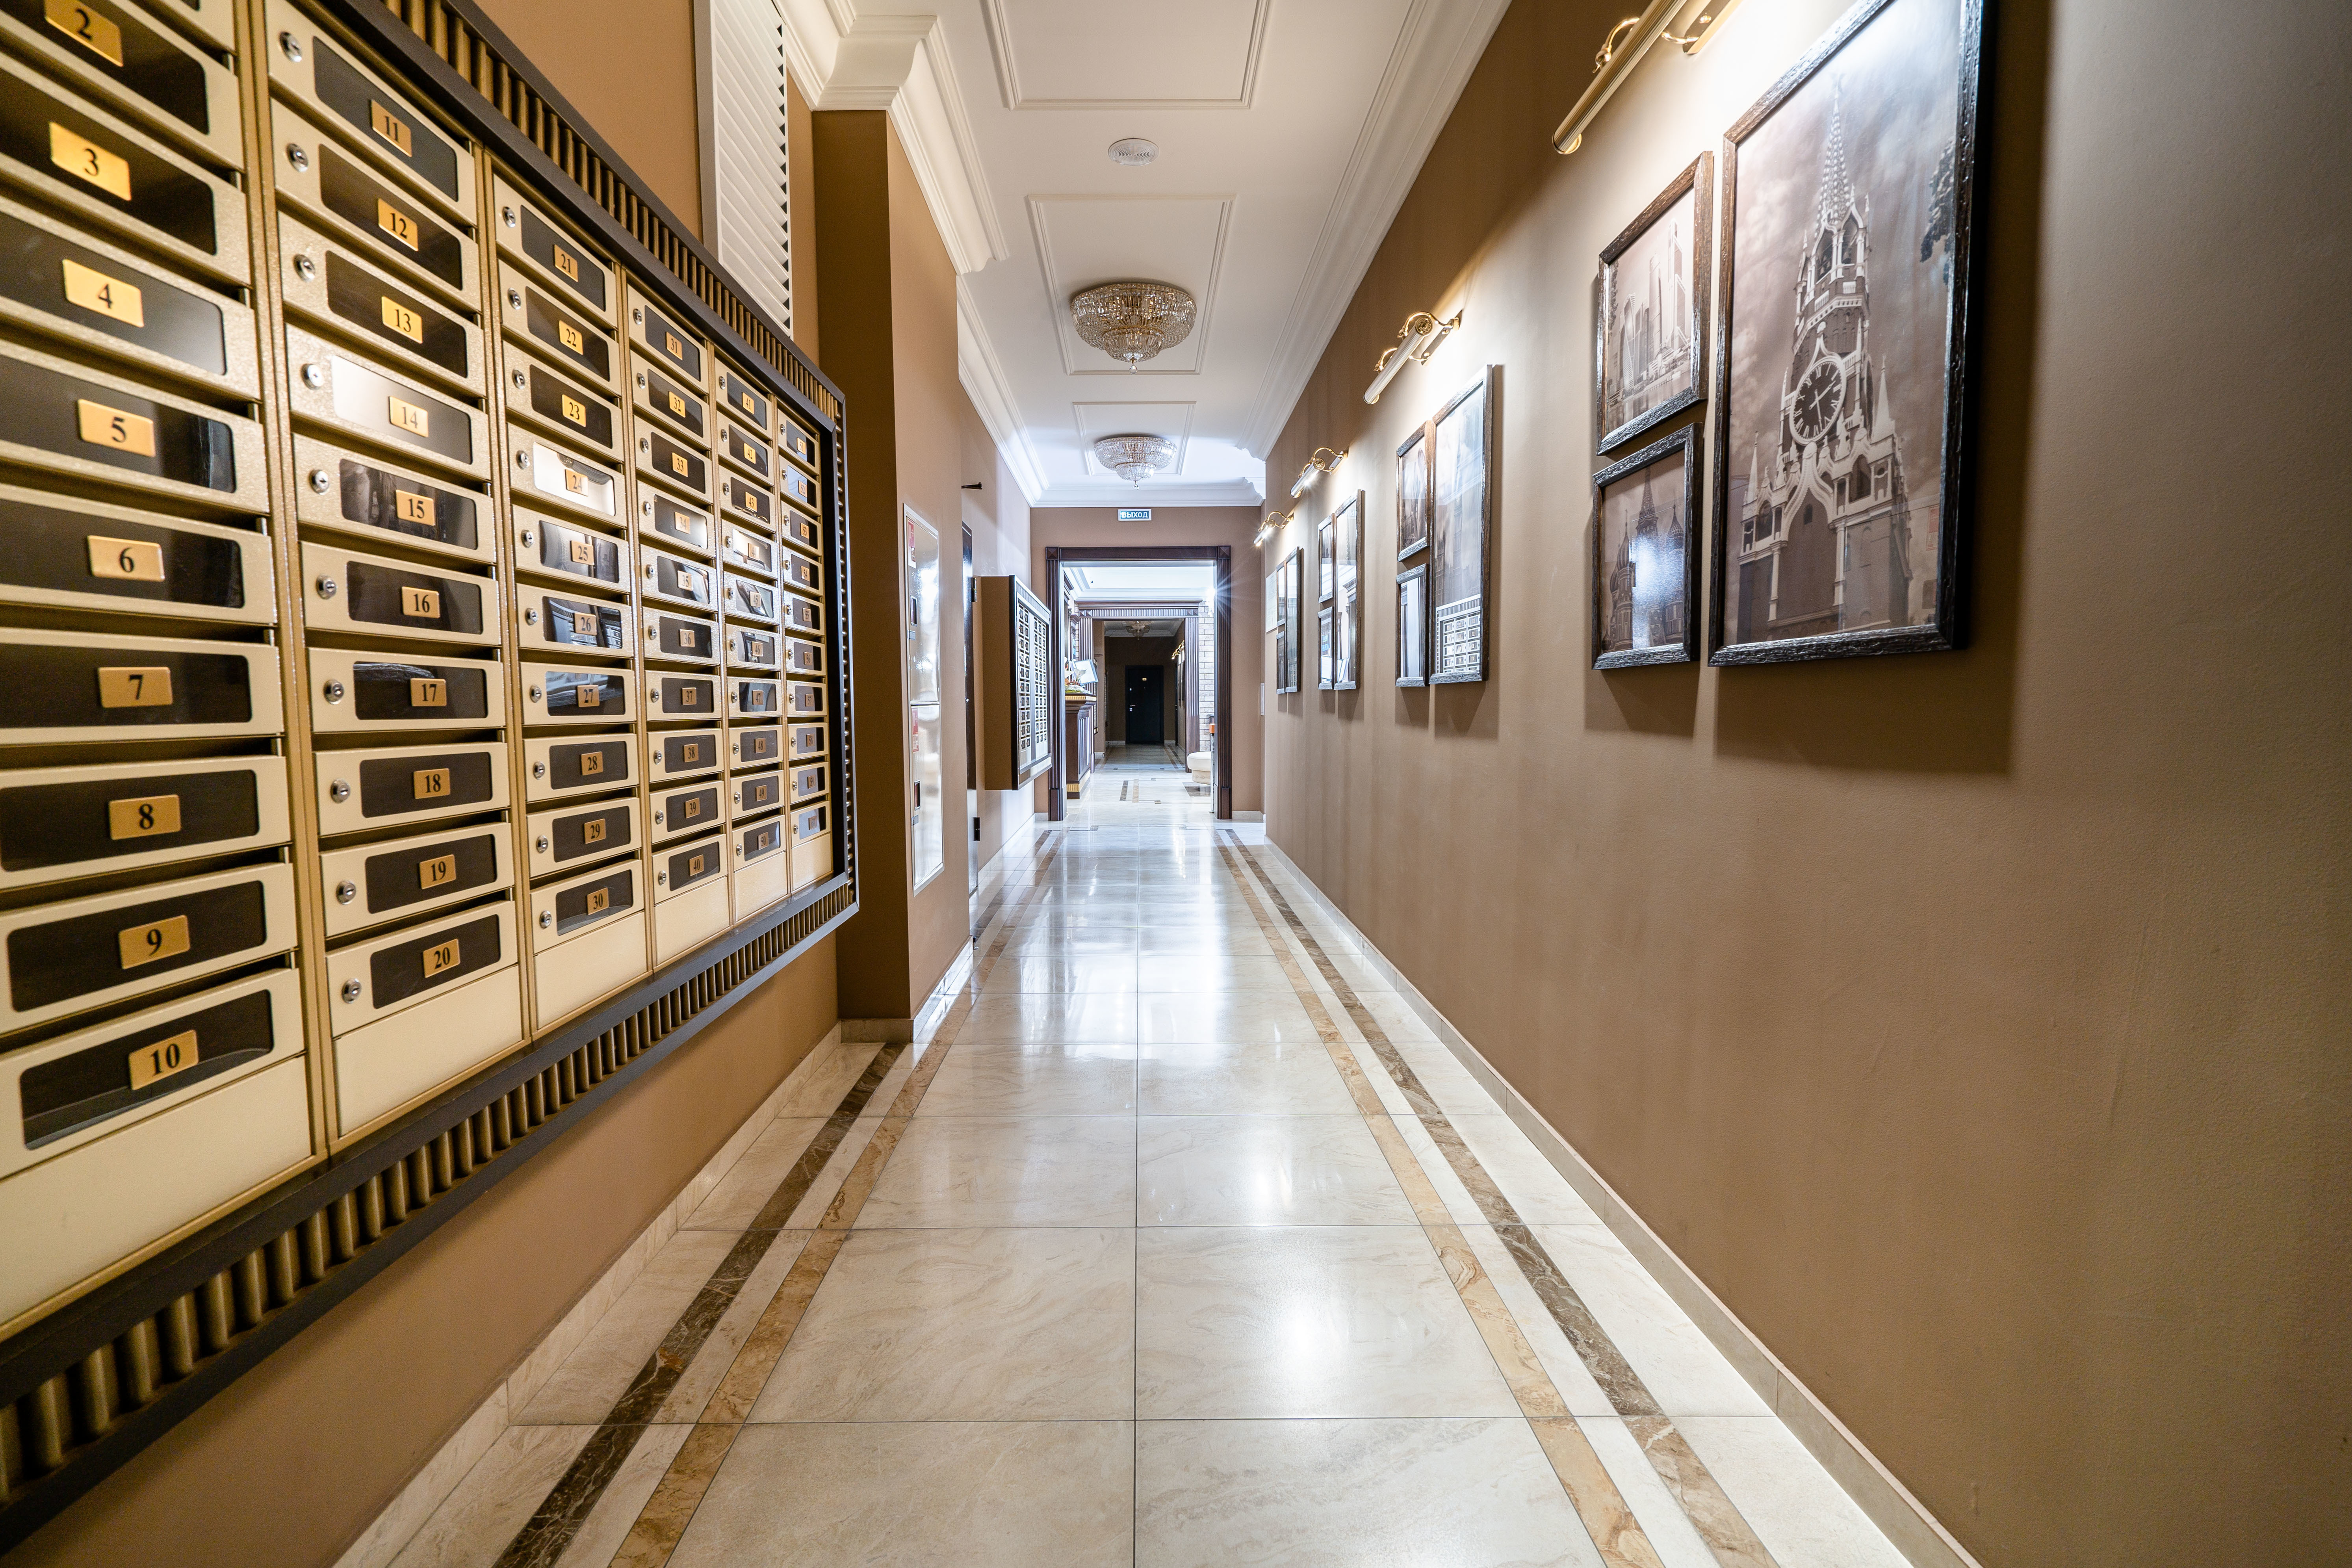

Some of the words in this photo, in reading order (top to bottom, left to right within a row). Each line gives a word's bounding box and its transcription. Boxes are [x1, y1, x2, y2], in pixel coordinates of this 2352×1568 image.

[75, 9, 92, 40] 2
[385, 116, 399, 143] 11
[84, 149, 98, 176] 3
[390, 213, 407, 239] 12
[561, 253, 572, 274] 21
[98, 284, 113, 308] 4
[395, 311, 411, 332] 13
[566, 328, 576, 347] 22
[670, 340, 678, 353] 31
[569, 401, 580, 421] 23
[674, 398, 681, 412] 32
[746, 397, 751, 409] 41
[402, 406, 418, 429] 14
[111, 417, 126, 443] 5
[747, 447, 753, 458] 42
[677, 458, 684, 471] 33
[572, 473, 583, 492] 24
[408, 498, 424, 519] 15
[748, 495, 754, 507] 43
[679, 517, 686, 530] 34
[120, 547, 134, 572] 6
[578, 544, 588, 561] 25
[682, 575, 689, 586] 35
[414, 594, 430, 612] 16
[753, 595, 758, 605] 45
[580, 616, 591, 631] 26
[684, 633, 691, 645] 36
[755, 644, 760, 654] 46
[129, 674, 143, 700] 7
[422, 683, 437, 701] 17
[584, 688, 594, 703] 27
[686, 691, 693, 702] 37
[756, 692, 761, 702] 47
[688, 747, 695, 758] 38
[757, 741, 763, 750] 48
[587, 757, 597, 770] 28
[425, 774, 441, 793] 18
[759, 789, 764, 798] 49
[689, 802, 696, 814] 39
[139, 804, 154, 829] 8
[590, 824, 600, 839] 29
[760, 836, 766, 846] 50
[431, 862, 446, 881] 19
[693, 859, 700, 871] 40
[593, 894, 603, 908] 30
[147, 929, 162, 956] 9
[434, 947, 450, 968] 20
[150, 1044, 181, 1076] 10
